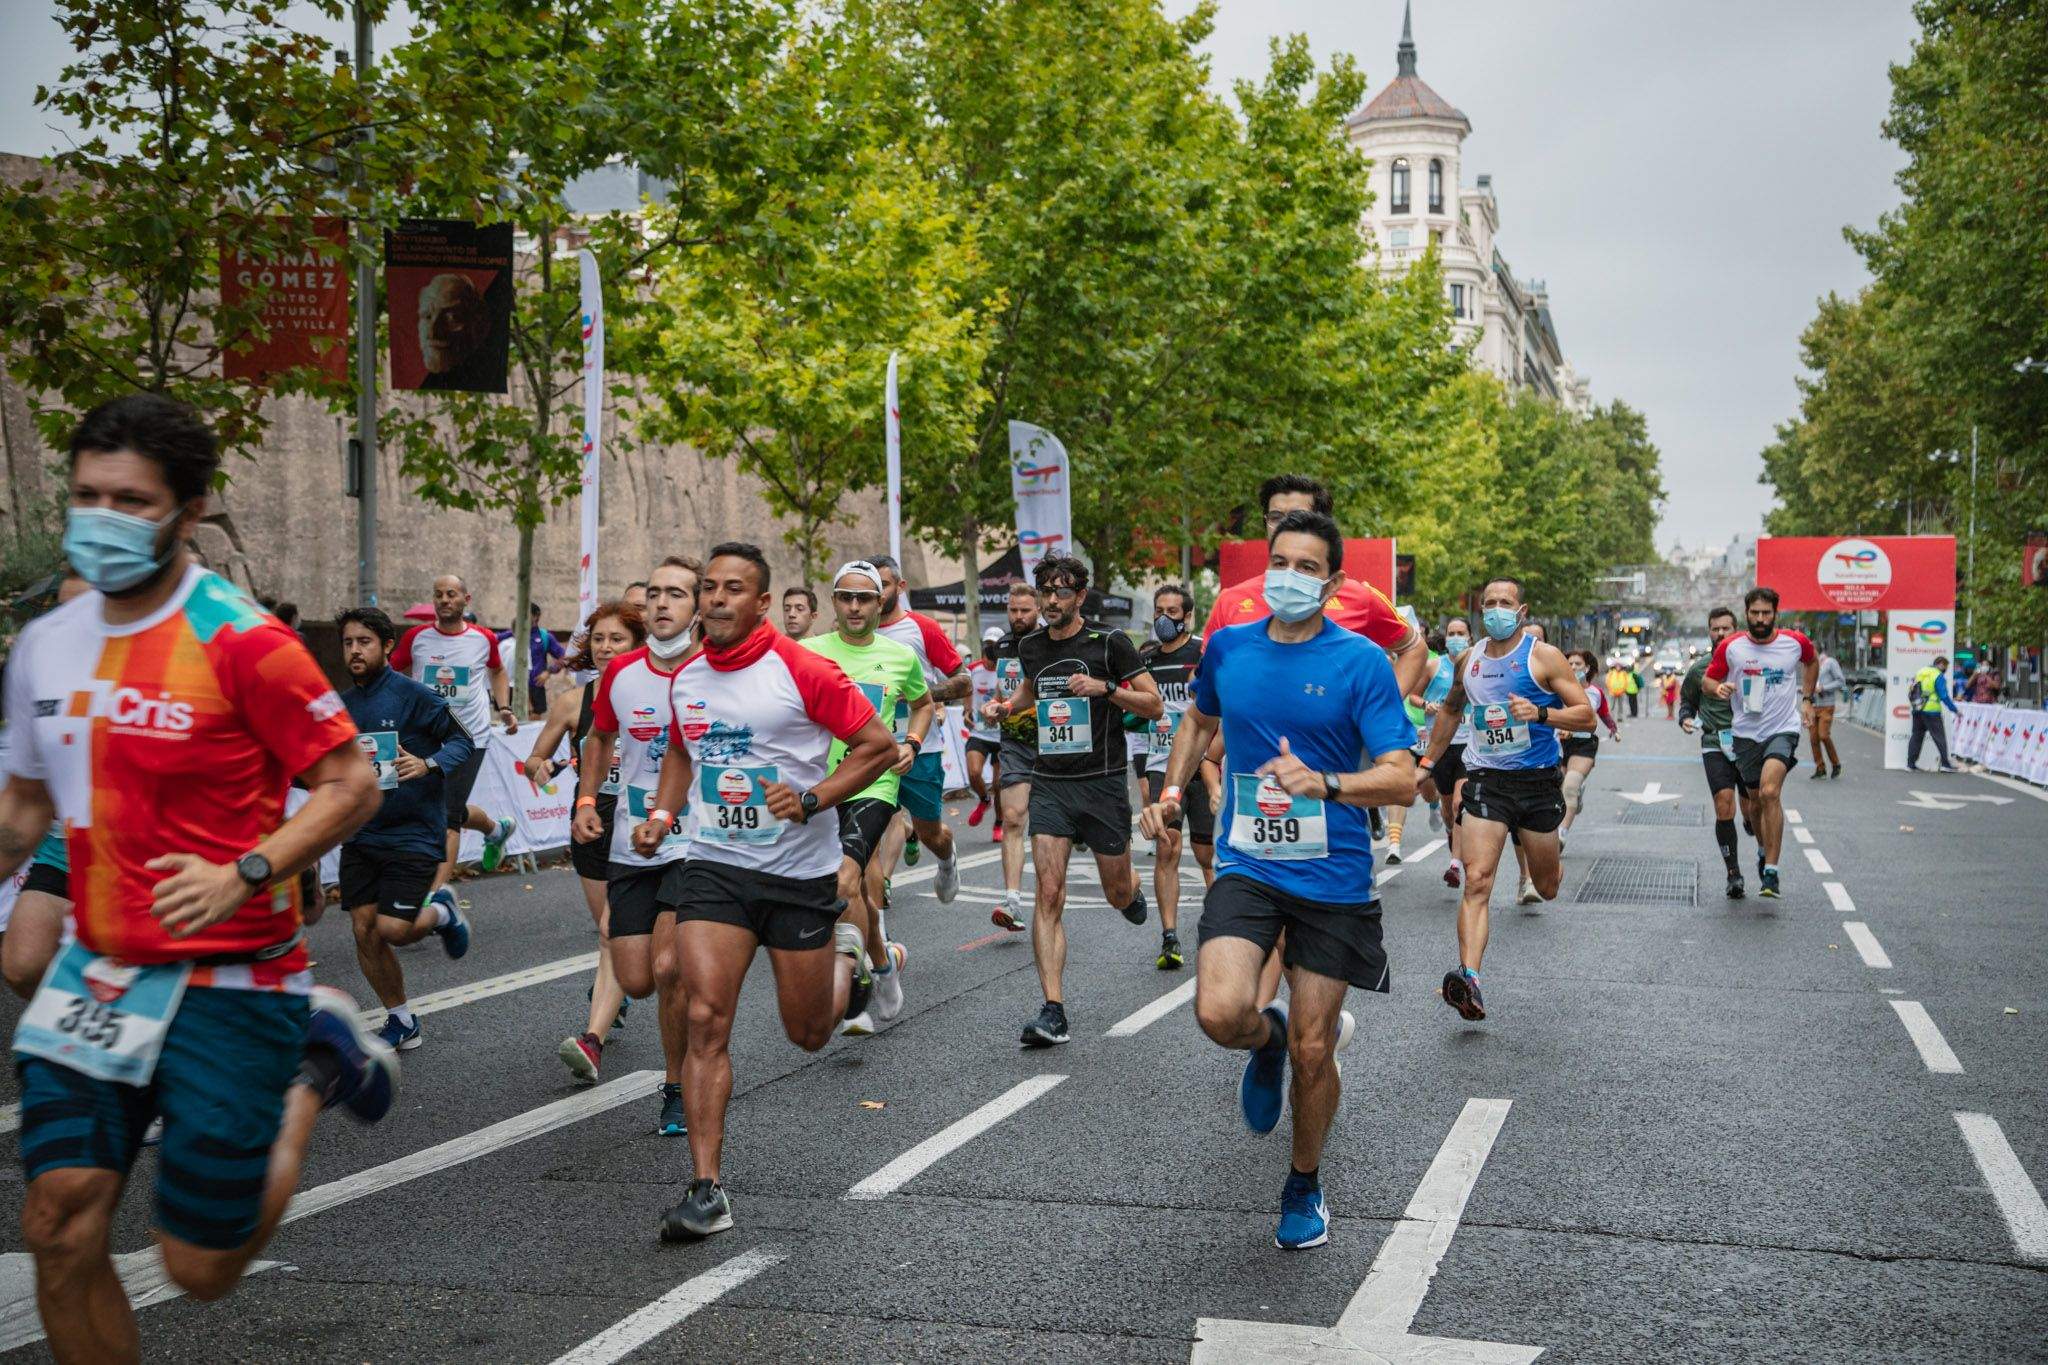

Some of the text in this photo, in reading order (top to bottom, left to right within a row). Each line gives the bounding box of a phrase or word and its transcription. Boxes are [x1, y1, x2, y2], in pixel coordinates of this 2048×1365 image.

[236, 267, 336, 289] GÓMEZ
[268, 293, 319, 303] ENTRO
[263, 306, 326, 317] LTURAL
[293, 321, 337, 330] VILLA
[434, 685, 457, 698] 330
[109, 687, 194, 731] Cris
[1049, 726, 1074, 742] 341
[1486, 728, 1514, 745] 354
[718, 805, 760, 829] 349
[1253, 817, 1299, 843] 359
